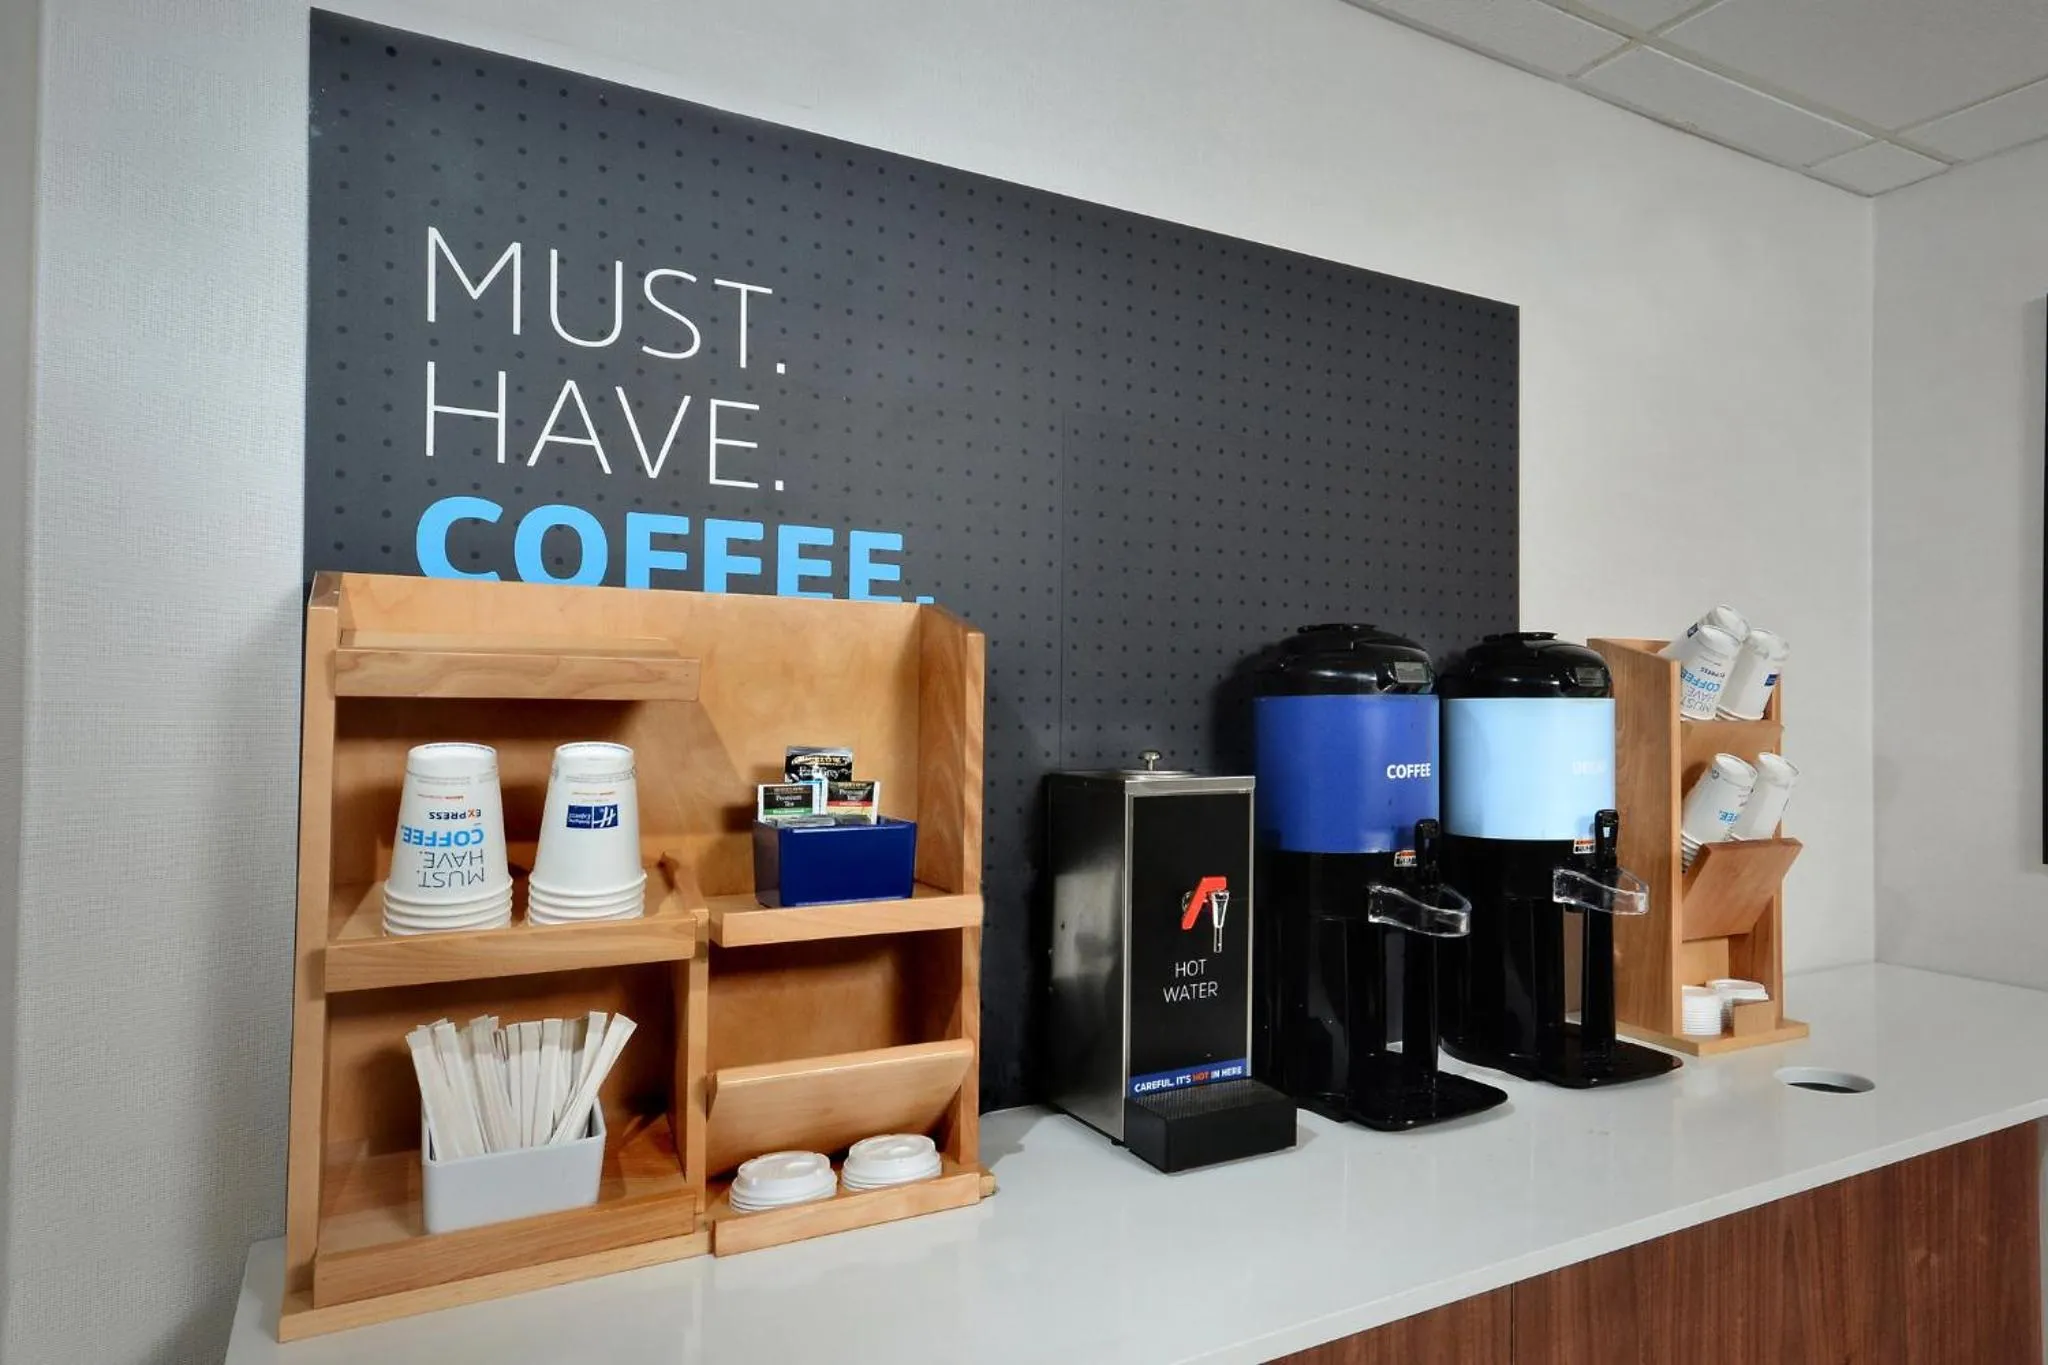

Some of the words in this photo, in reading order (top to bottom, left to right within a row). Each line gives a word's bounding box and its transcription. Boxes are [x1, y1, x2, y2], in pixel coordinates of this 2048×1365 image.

[426, 225, 786, 376] MUST.
[424, 360, 786, 492] HAVE.
[1386, 762, 1432, 780] COFFEE
[427, 807, 482, 821] EXPRESS
[401, 825, 485, 849] COFFEE.
[418, 848, 485, 870] HAVE.
[416, 868, 486, 889] MUST.
[1174, 958, 1208, 979] HOT
[1162, 980, 1220, 1004] WATER
[1176, 1074, 1192, 1085] IT'S
[1192, 1071, 1210, 1083] HOT
[1210, 1069, 1220, 1080] IN
[1221, 1065, 1243, 1078] HERE
